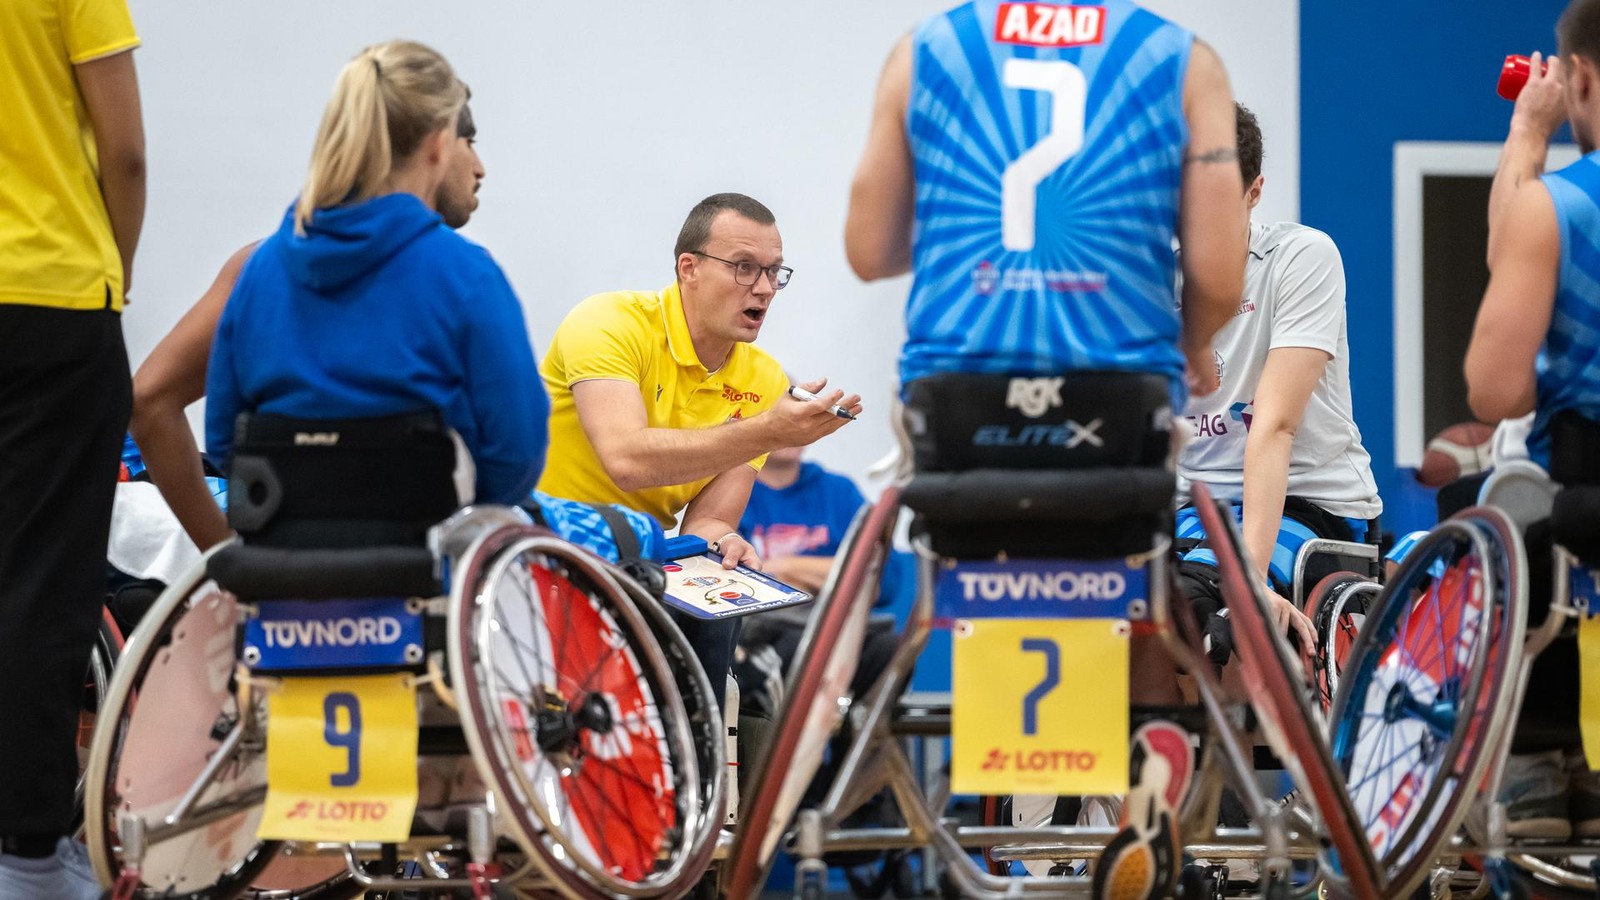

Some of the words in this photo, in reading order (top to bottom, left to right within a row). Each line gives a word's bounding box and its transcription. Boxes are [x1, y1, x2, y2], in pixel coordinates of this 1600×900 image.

[1001, 4, 1101, 43] AZAD
[1003, 58, 1087, 251] 7
[730, 391, 760, 403] LOTTO
[958, 571, 1125, 599] TÜVNORD
[261, 616, 401, 648] TÜVNORD
[1021, 638, 1061, 736] 7
[324, 692, 361, 787] 9
[1015, 751, 1096, 772] LOTTO
[317, 801, 388, 821] LOTTO
